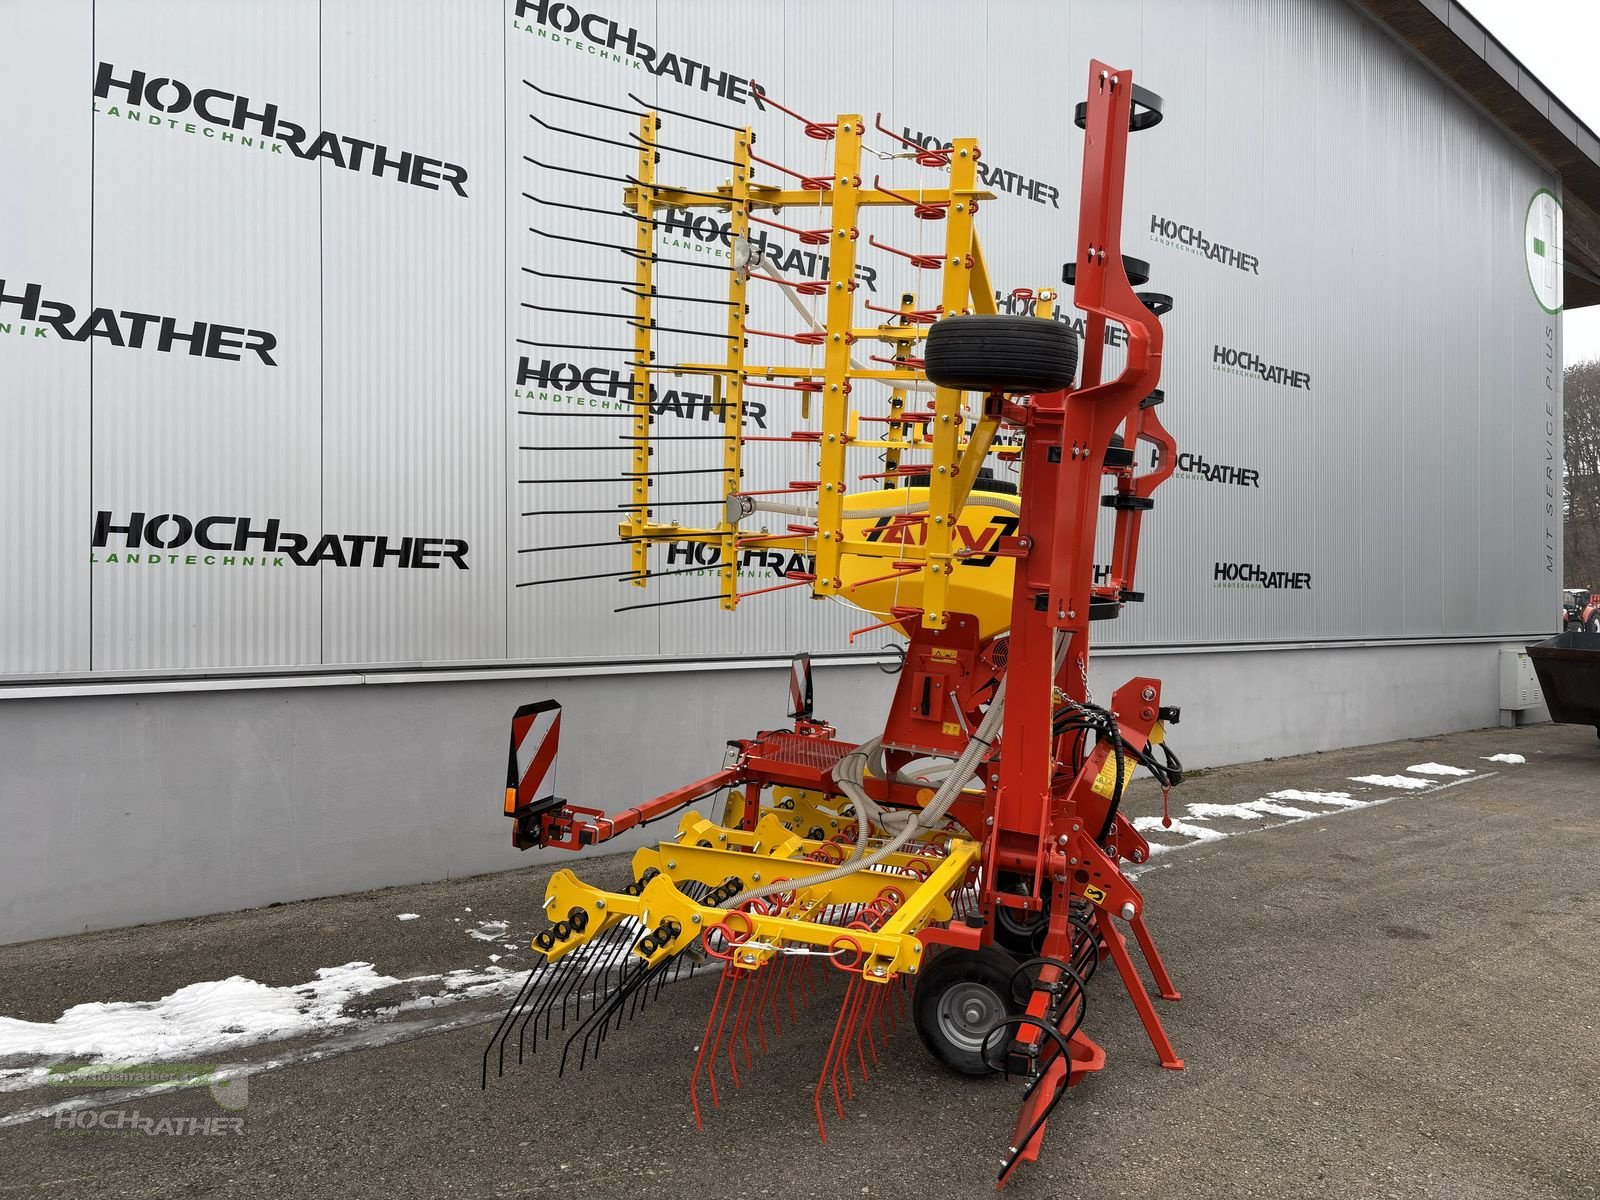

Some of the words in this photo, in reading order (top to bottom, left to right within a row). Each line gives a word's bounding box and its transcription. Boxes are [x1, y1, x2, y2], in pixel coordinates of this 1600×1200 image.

[513, 20, 641, 70] LANDTECHNIK
[92, 102, 283, 154] LANDTECHNIK
[94, 61, 468, 198] HOCHRATHER
[1150, 214, 1259, 276] HOCHRATHER
[1213, 345, 1311, 391] HOCHRATHER
[1545, 326, 1554, 391] PLUS
[1150, 448, 1260, 488] HCHRATHER
[1545, 402, 1554, 517] SERVICE
[90, 552, 285, 567] LANDTECHNIK
[92, 510, 470, 570] HOCHRATHER
[1545, 527, 1554, 573] MIT
[1214, 562, 1312, 590] HOCHRATHER
